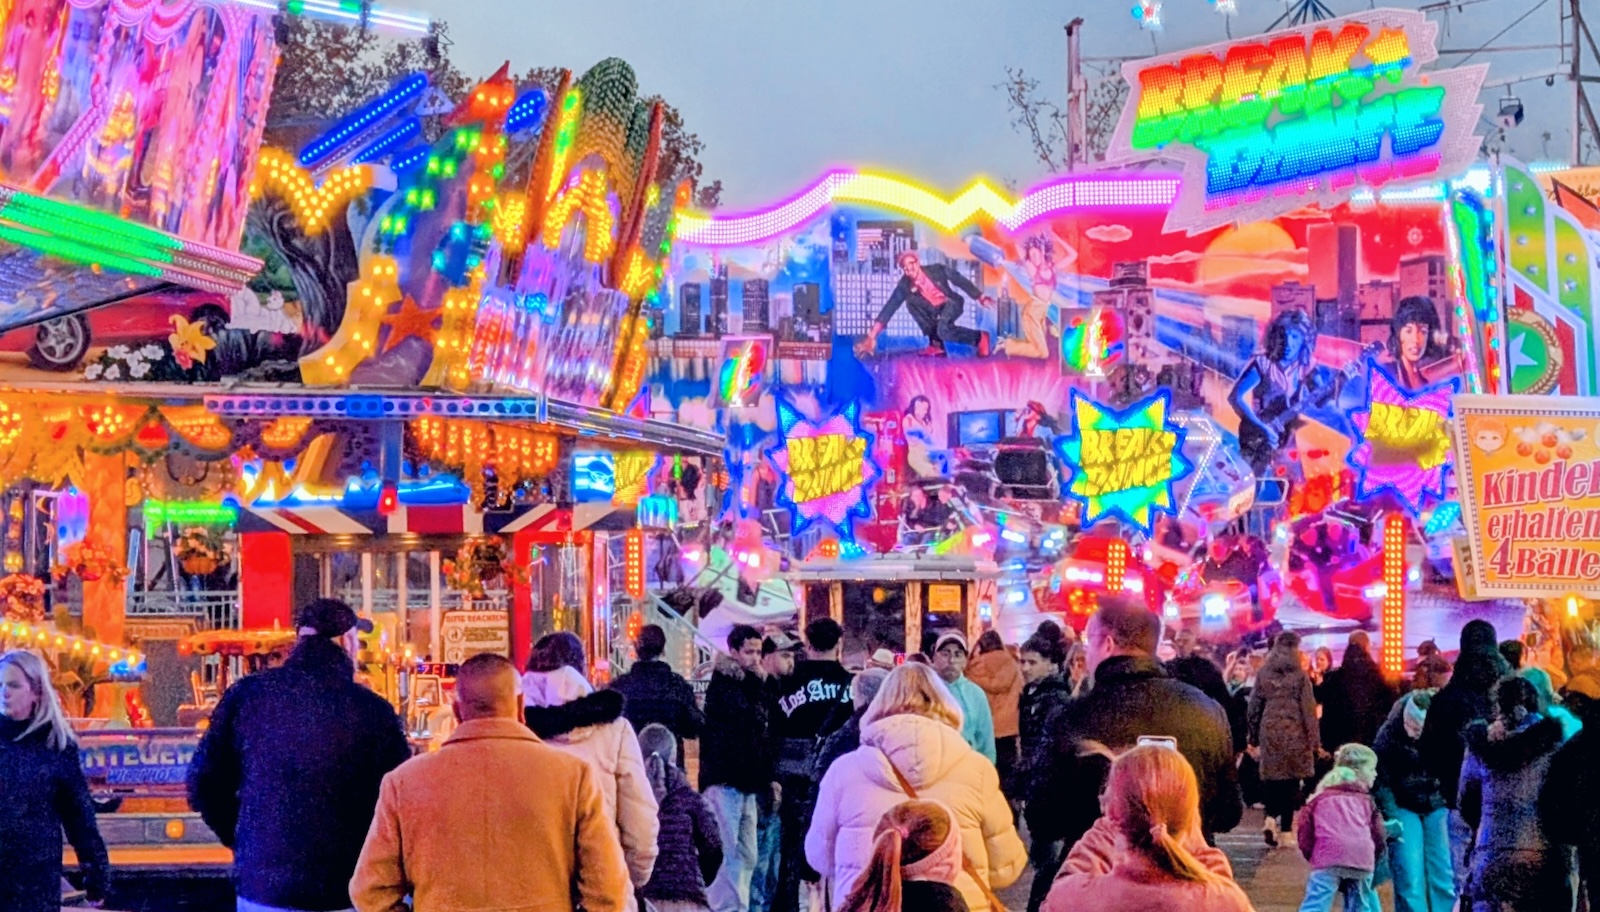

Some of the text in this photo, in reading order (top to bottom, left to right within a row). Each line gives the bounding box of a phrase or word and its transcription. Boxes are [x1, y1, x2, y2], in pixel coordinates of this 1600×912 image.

[786, 433, 856, 473] BREAK
[1080, 428, 1164, 466] BREAK
[1487, 506, 1600, 540] erhalten
[1489, 537, 1513, 576] 4
[1514, 546, 1600, 578] Bälle
[778, 686, 807, 718] Los
